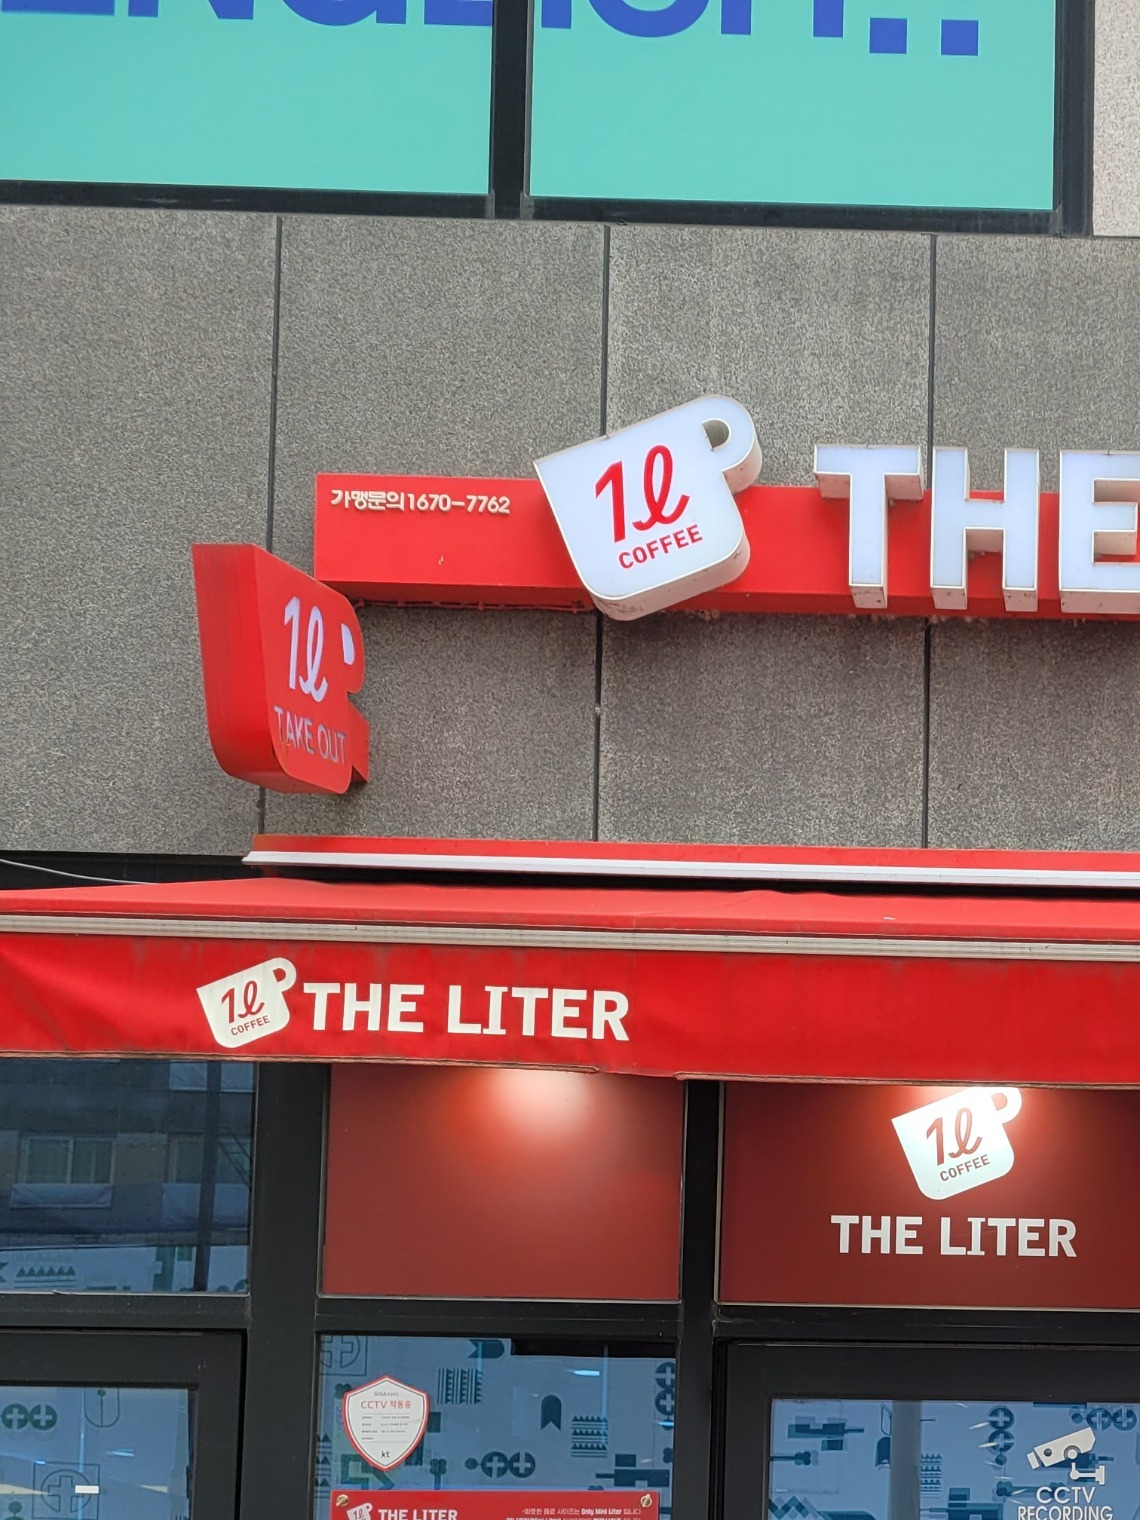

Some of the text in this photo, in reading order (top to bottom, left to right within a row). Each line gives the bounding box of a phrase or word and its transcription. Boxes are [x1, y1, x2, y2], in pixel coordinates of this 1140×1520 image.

[618, 524, 703, 569] COFFEE
[274, 706, 347, 765] TAKE OUT
[231, 1015, 270, 1036] COFFEE
[304, 982, 629, 1041] THE LITER
[940, 1154, 990, 1181] COFFEE
[831, 1215, 1077, 1257] THE LITER
[361, 1401, 387, 1409] CCTV
[1037, 1487, 1095, 1503] CCTV
